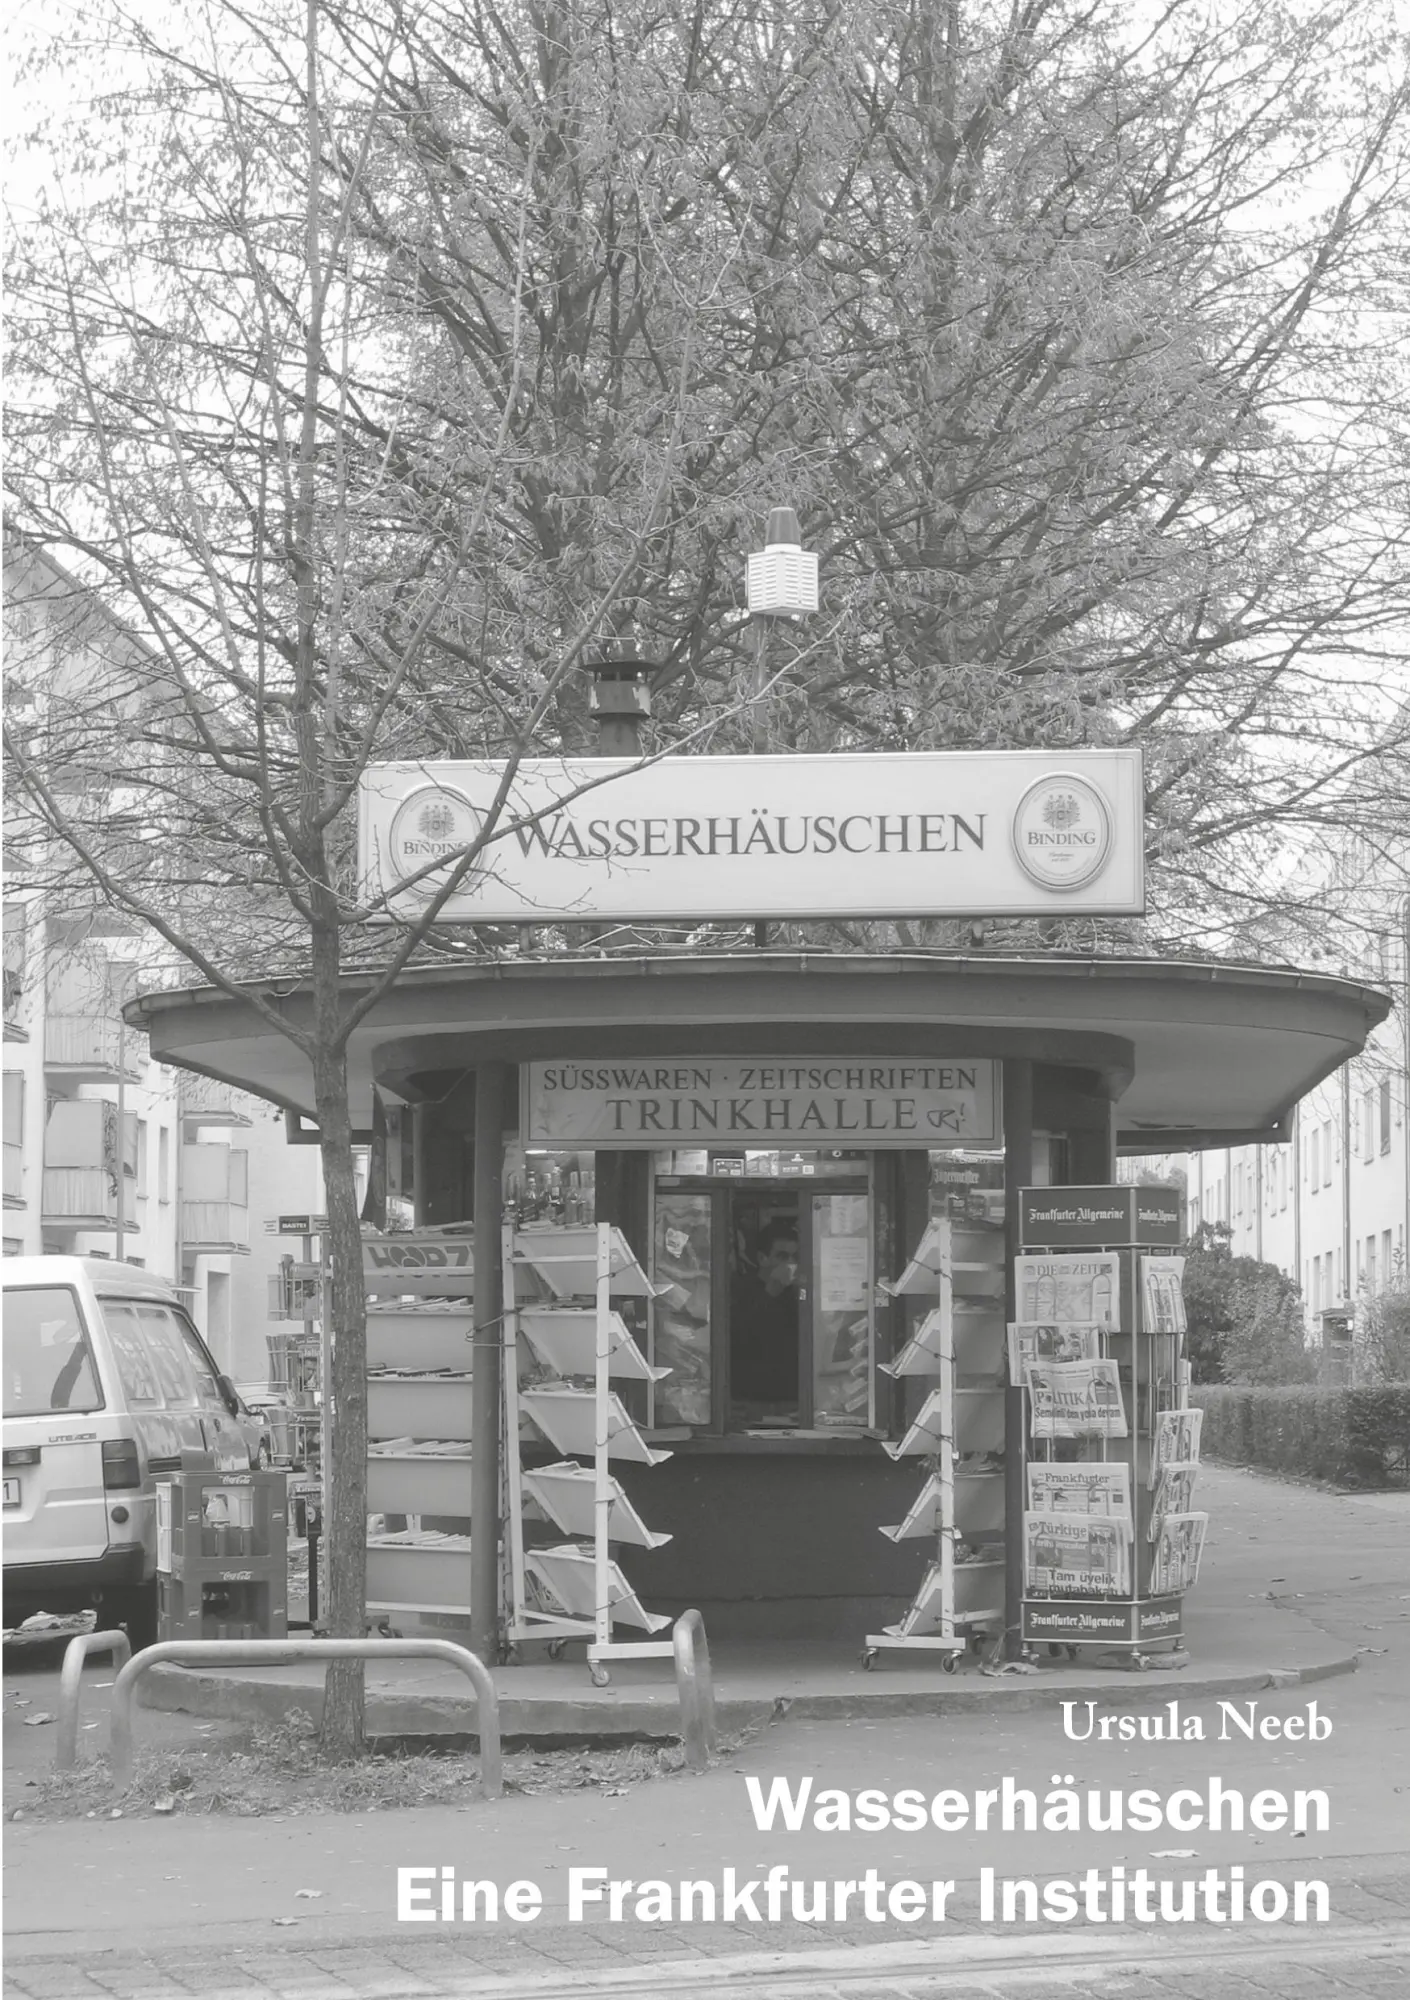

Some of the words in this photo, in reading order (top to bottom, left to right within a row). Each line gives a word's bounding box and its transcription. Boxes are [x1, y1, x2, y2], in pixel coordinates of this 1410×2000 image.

[508, 807, 986, 858] WASSERHÄUSCHEN
[1027, 831, 1096, 845] BINDING
[543, 1064, 713, 1090] SÜSSWAREN
[739, 1067, 978, 1090] ZEITSCHRIFTEN
[606, 1098, 919, 1131] TRINKHALLE
[1037, 1264, 1058, 1276] DIE
[1072, 1263, 1098, 1275] ZEIT
[1045, 1472, 1110, 1484] Frankfurter
[1048, 1569, 1076, 1582] Tam
[1080, 1571, 1116, 1585] üyelik
